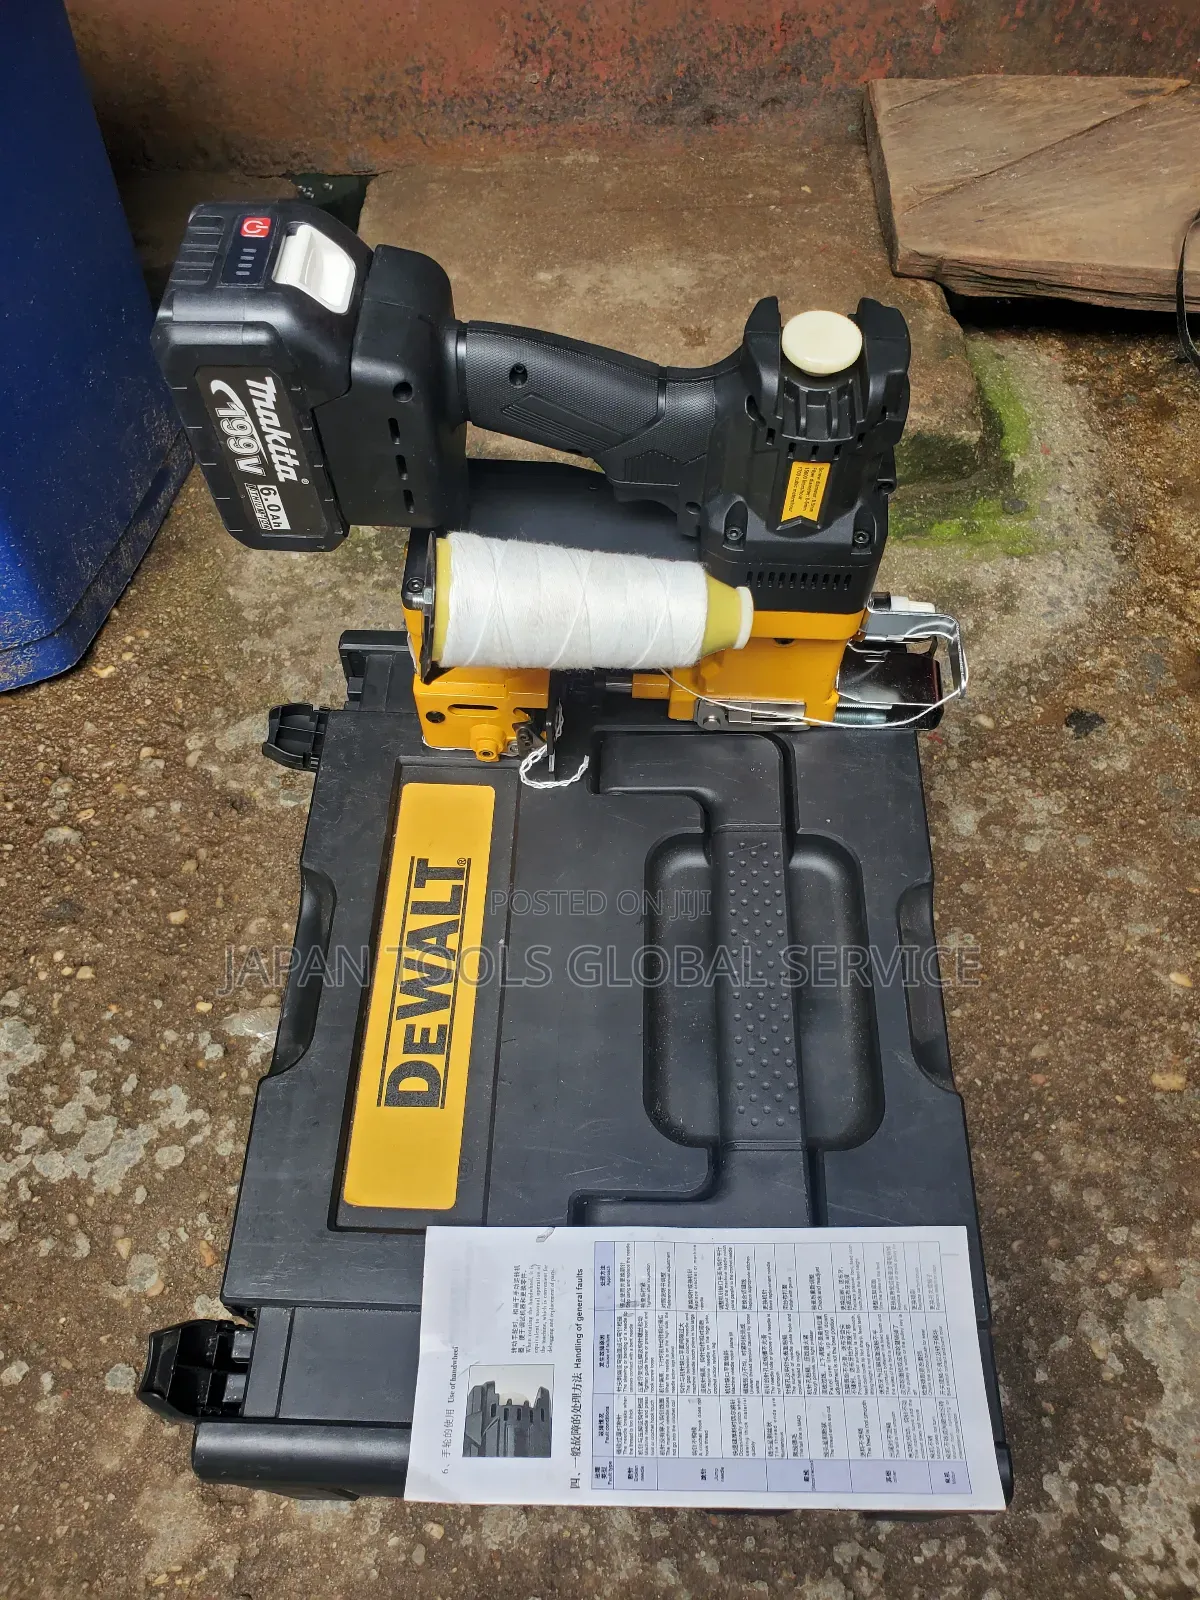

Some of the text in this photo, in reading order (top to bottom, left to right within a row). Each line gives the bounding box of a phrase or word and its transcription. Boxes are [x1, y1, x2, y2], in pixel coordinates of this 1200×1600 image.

[574, 1269, 584, 1368] Handling of general faults
[569, 1373, 583, 1489] 四、一般故障的处理方法
